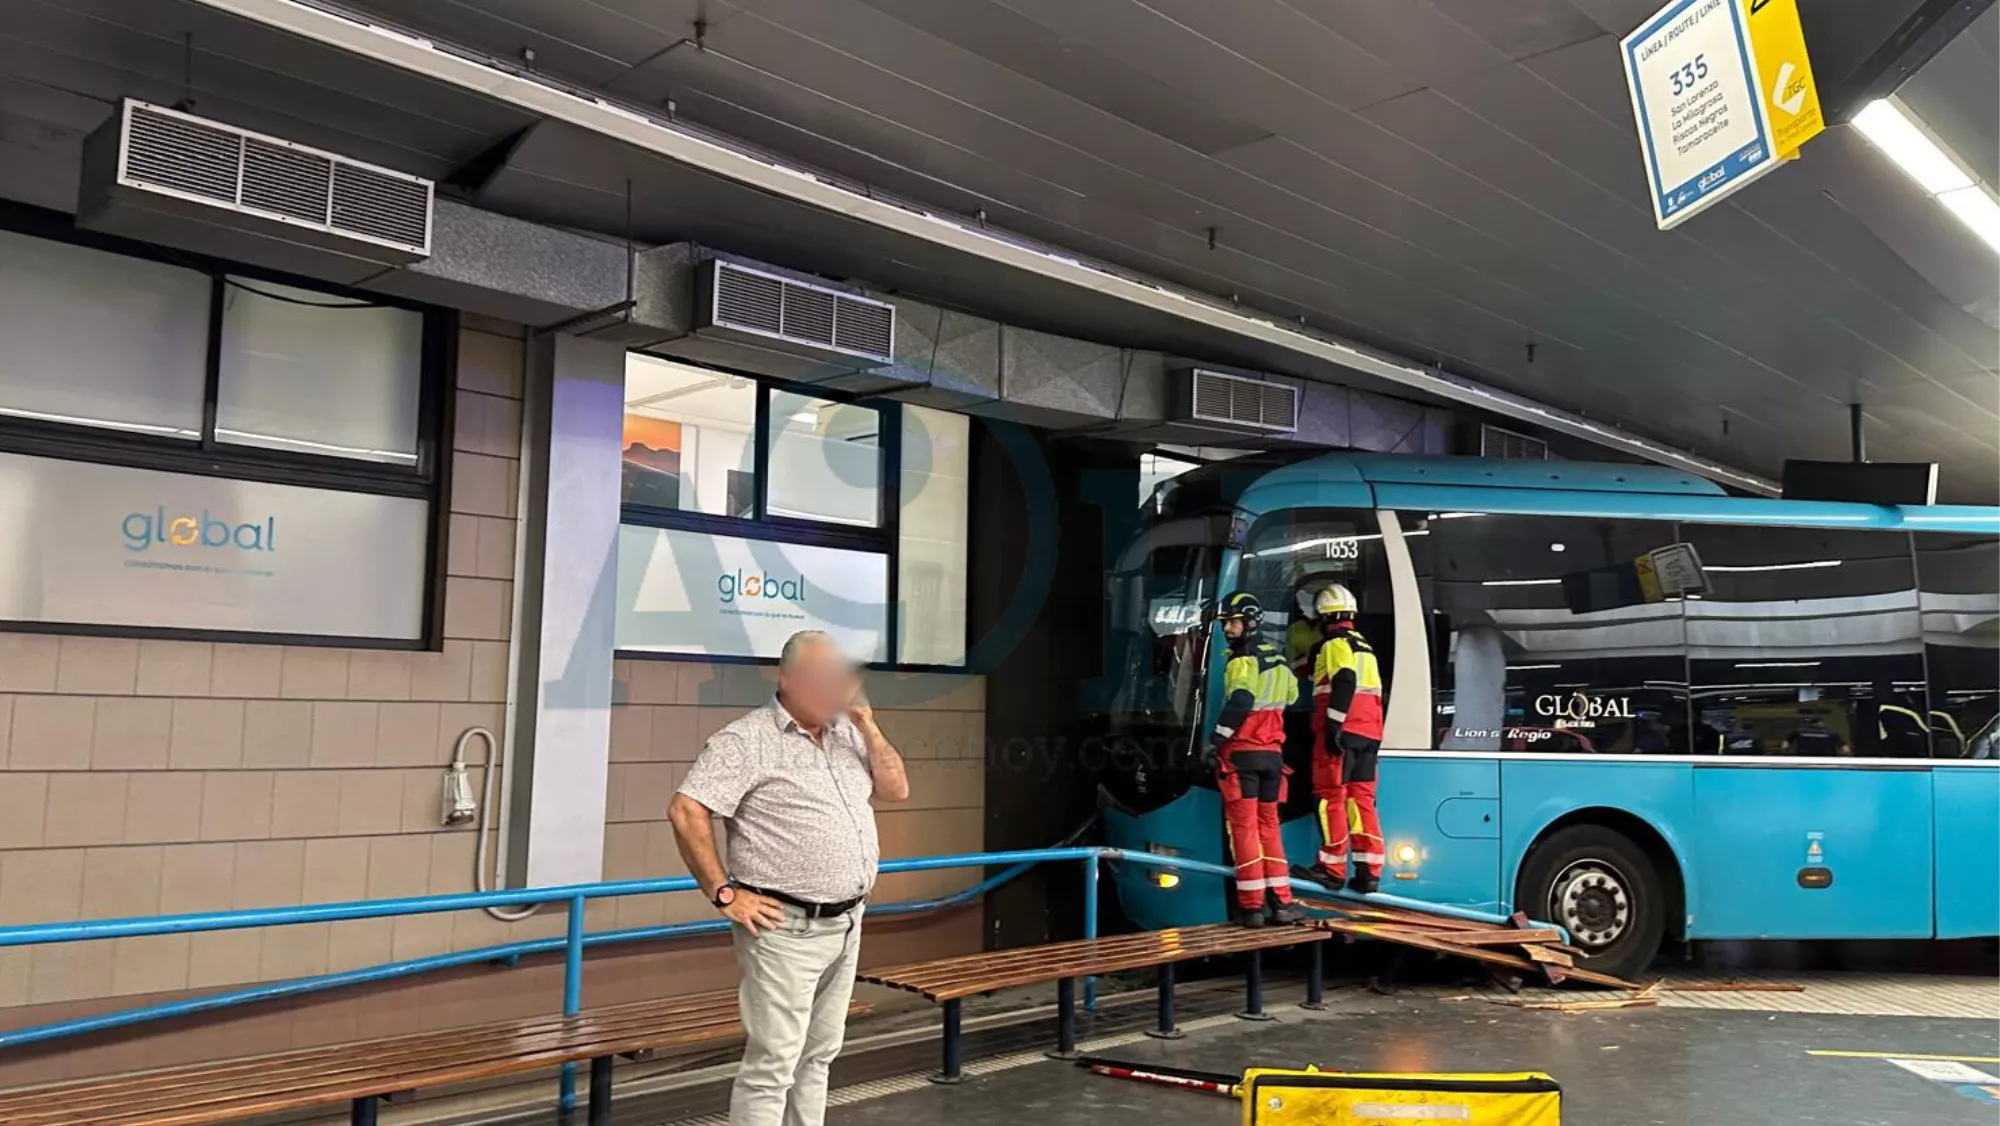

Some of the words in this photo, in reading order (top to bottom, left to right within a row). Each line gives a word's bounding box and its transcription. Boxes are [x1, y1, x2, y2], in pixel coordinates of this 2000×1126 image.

[1641, 39, 1664, 61] LÍNEA
[1668, 14, 1695, 42] ROUTE
[1669, 54, 1709, 96] 335
[1787, 76, 1807, 98] TGC
[1670, 101, 1687, 117] San
[1686, 80, 1720, 109] Lorenzo
[1671, 115, 1685, 131] La
[1684, 91, 1724, 127] Milagrosa
[1672, 121, 1699, 146] Riscos
[1698, 104, 1729, 133] Negros
[1677, 118, 1730, 156] Tamaraceite
[122, 505, 275, 551] global
[1326, 539, 1358, 559] 1653
[718, 568, 805, 603] global
[1535, 692, 1637, 719] GLOBAL
[1455, 727, 1501, 738] Lion's
[1507, 729, 1552, 742] Regio
